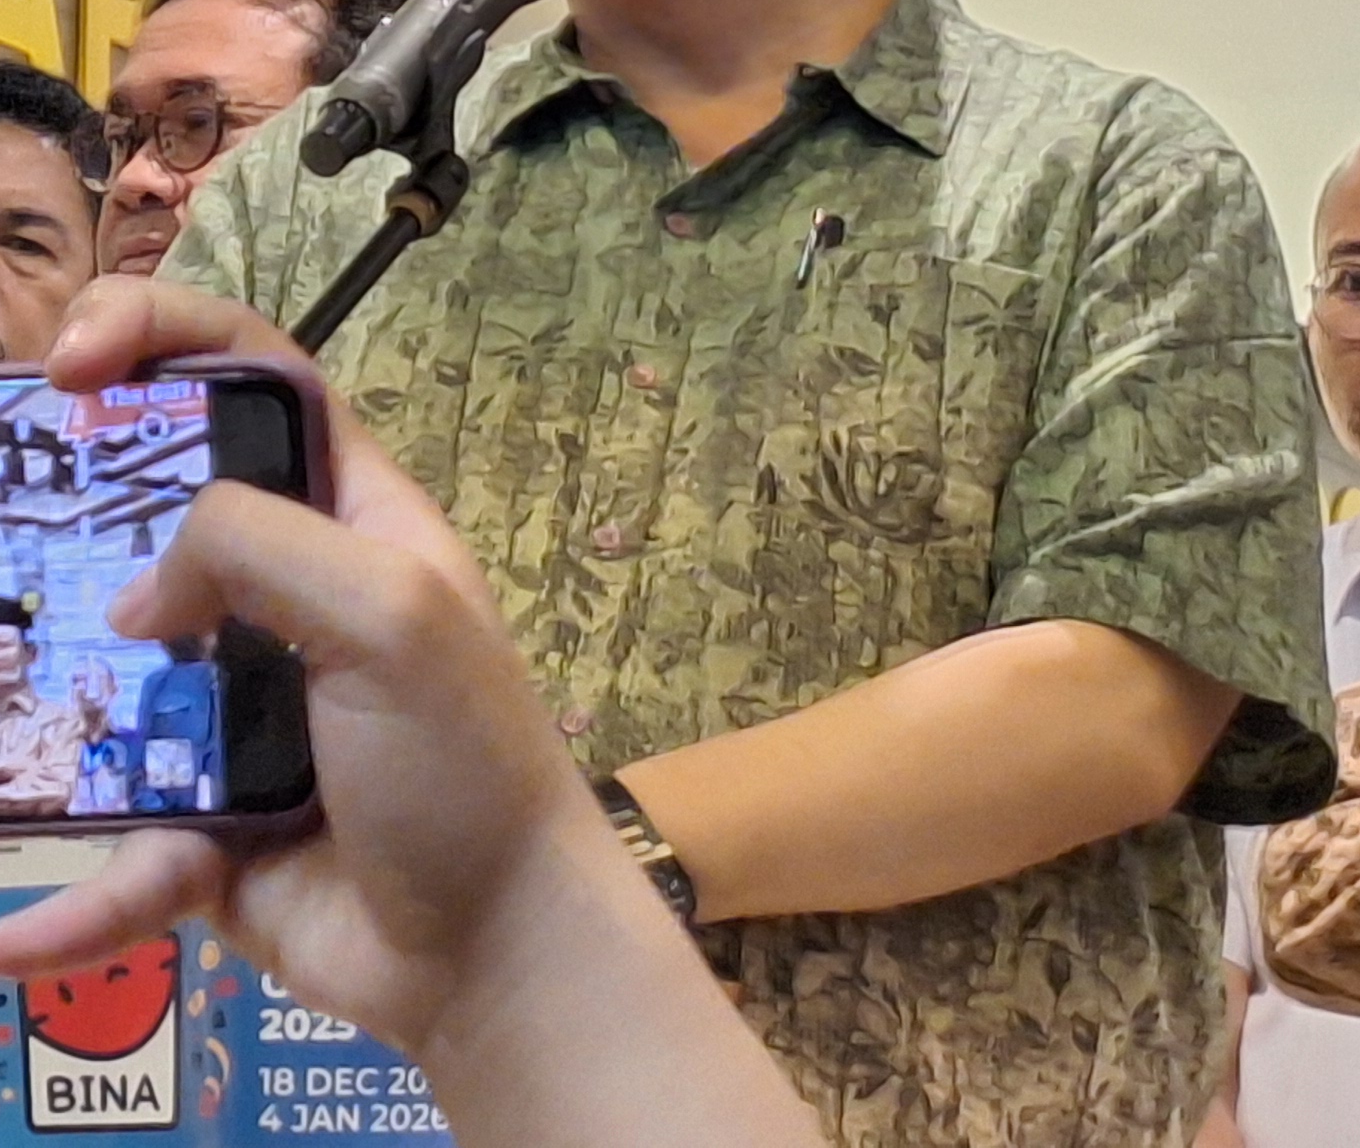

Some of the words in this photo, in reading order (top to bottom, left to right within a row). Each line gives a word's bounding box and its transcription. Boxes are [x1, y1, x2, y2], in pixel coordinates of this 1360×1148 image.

[46, 1073, 161, 1114] BINA
[258, 1066, 295, 1096] 18
[306, 1066, 380, 1096] DEC
[387, 1066, 434, 1095] 20
[257, 1103, 283, 1132] 4
[290, 1103, 361, 1133] JAN
